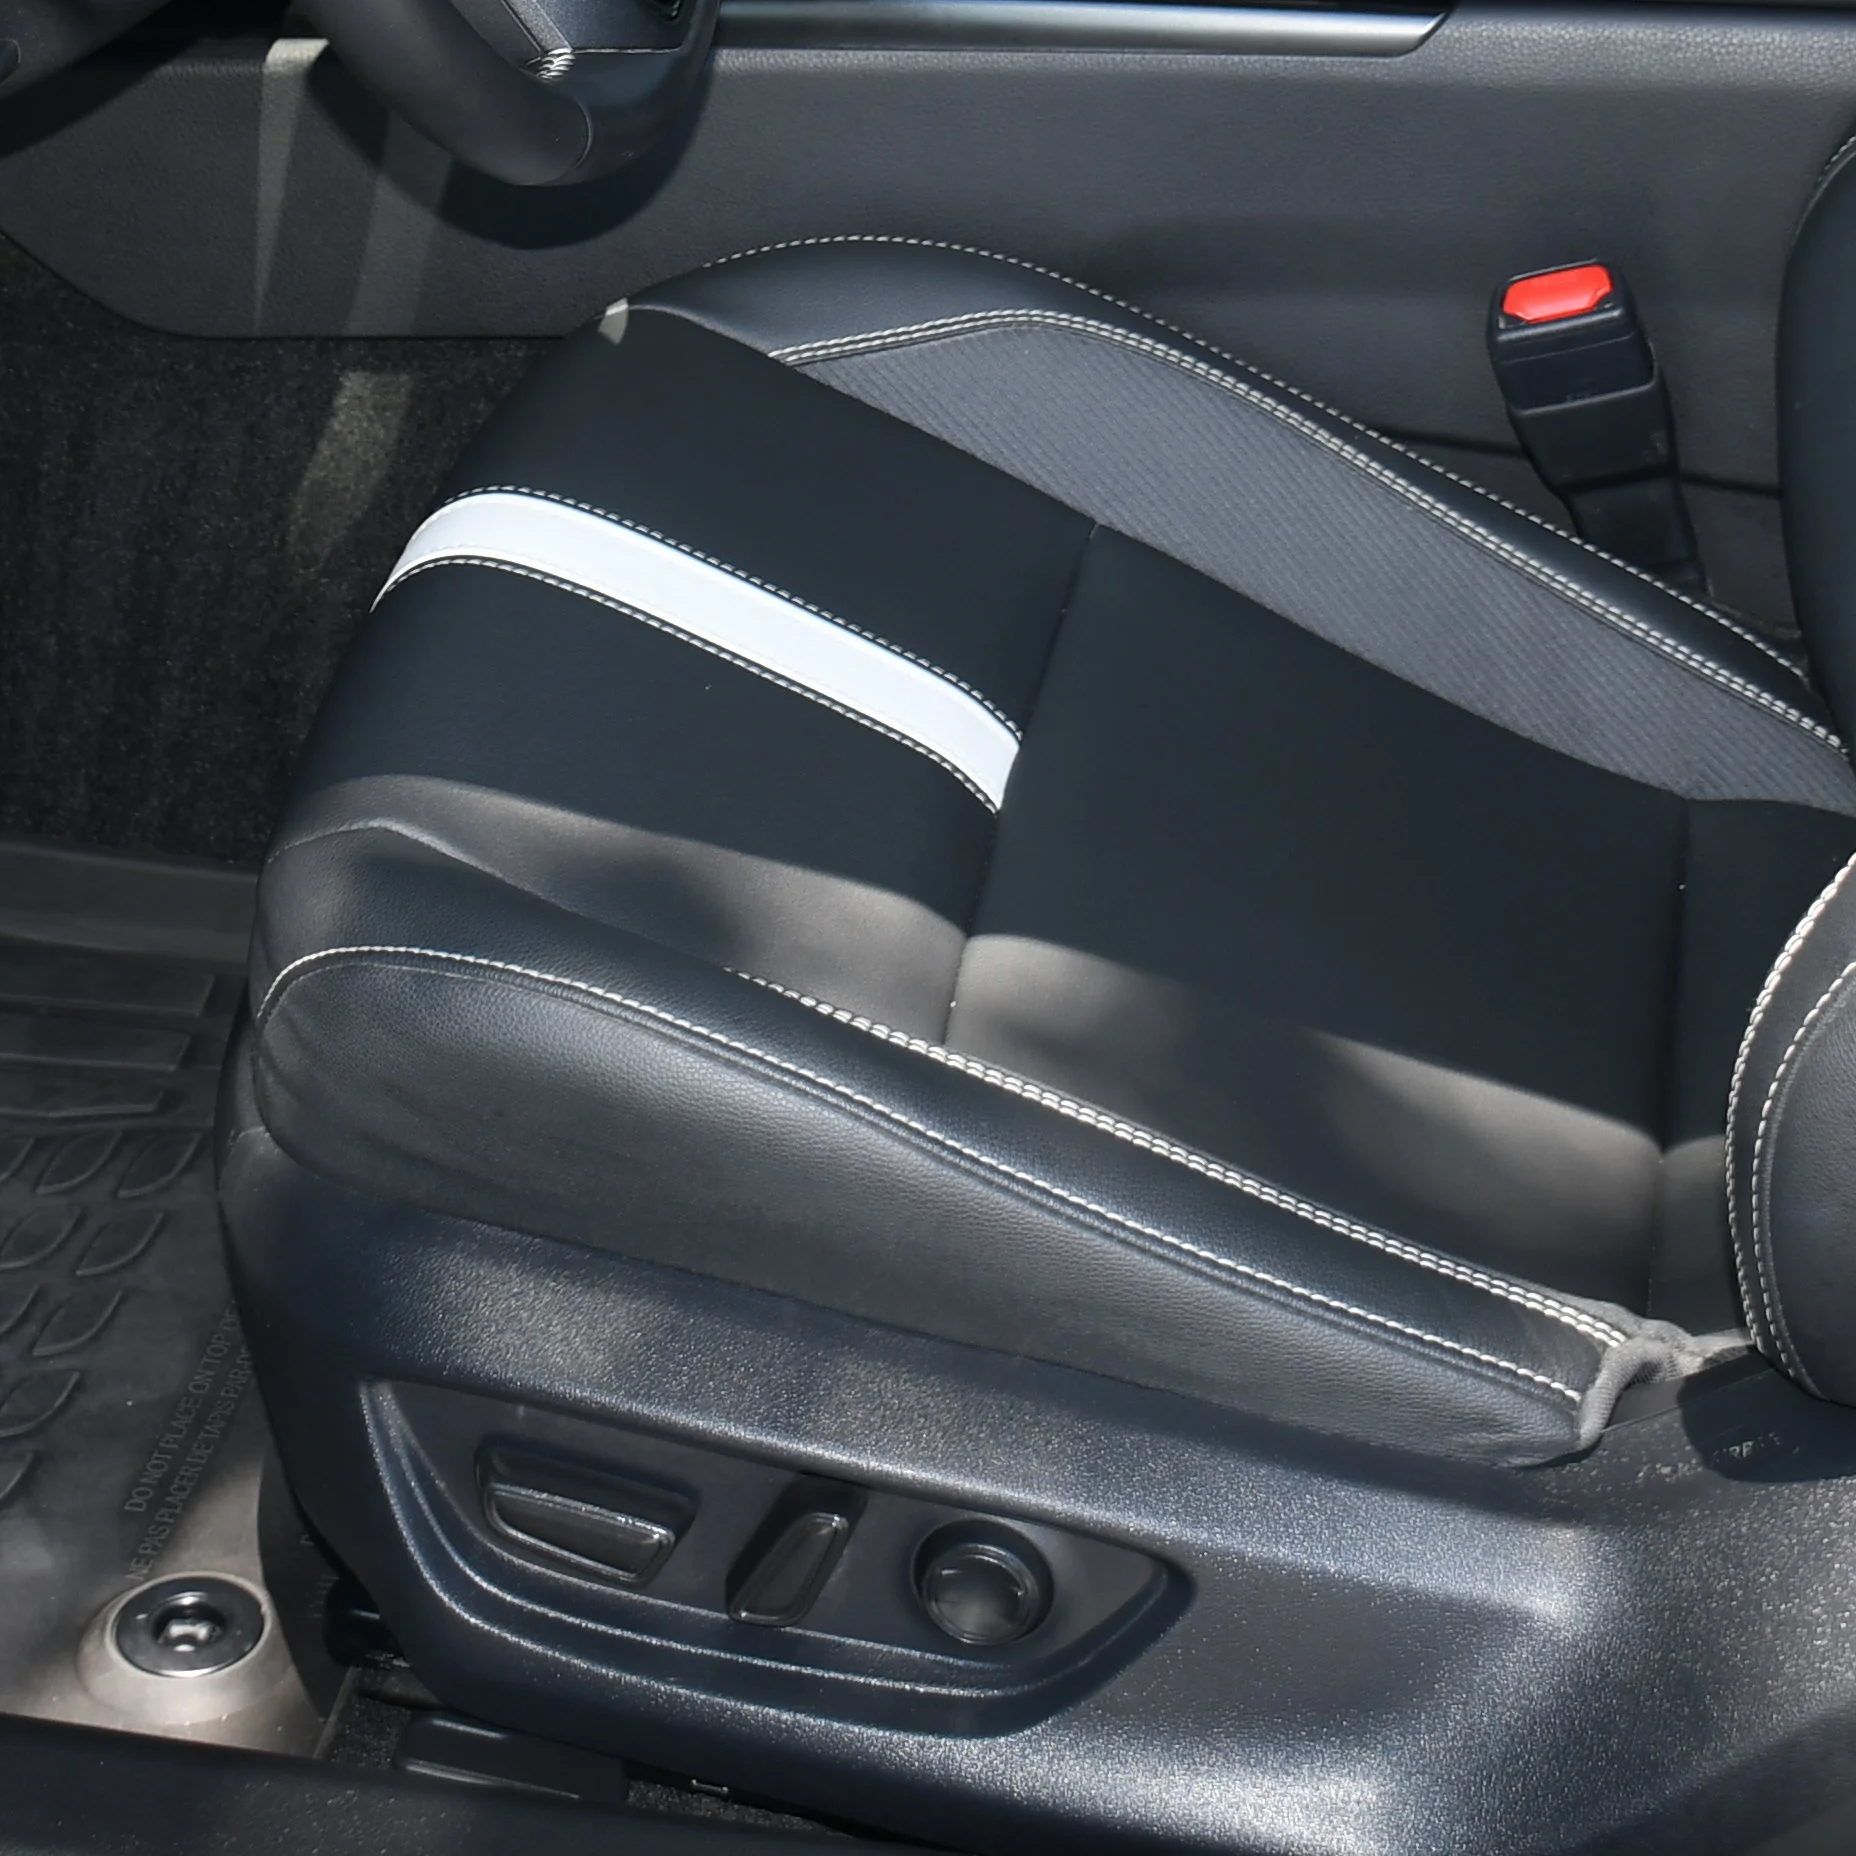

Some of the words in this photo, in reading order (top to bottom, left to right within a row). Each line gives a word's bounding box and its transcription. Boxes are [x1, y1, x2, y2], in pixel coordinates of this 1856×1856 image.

[124, 1485, 153, 1512] DO
[141, 1449, 172, 1484] NOT
[160, 1396, 203, 1449] PLACE
[188, 1367, 216, 1395] ON
[202, 1333, 231, 1369] TOP
[198, 1399, 236, 1441] TAPIS
[186, 1441, 214, 1468] DE
[155, 1465, 202, 1525] PLACER
[138, 1524, 171, 1559] PAS
[124, 1556, 154, 1587] NE
